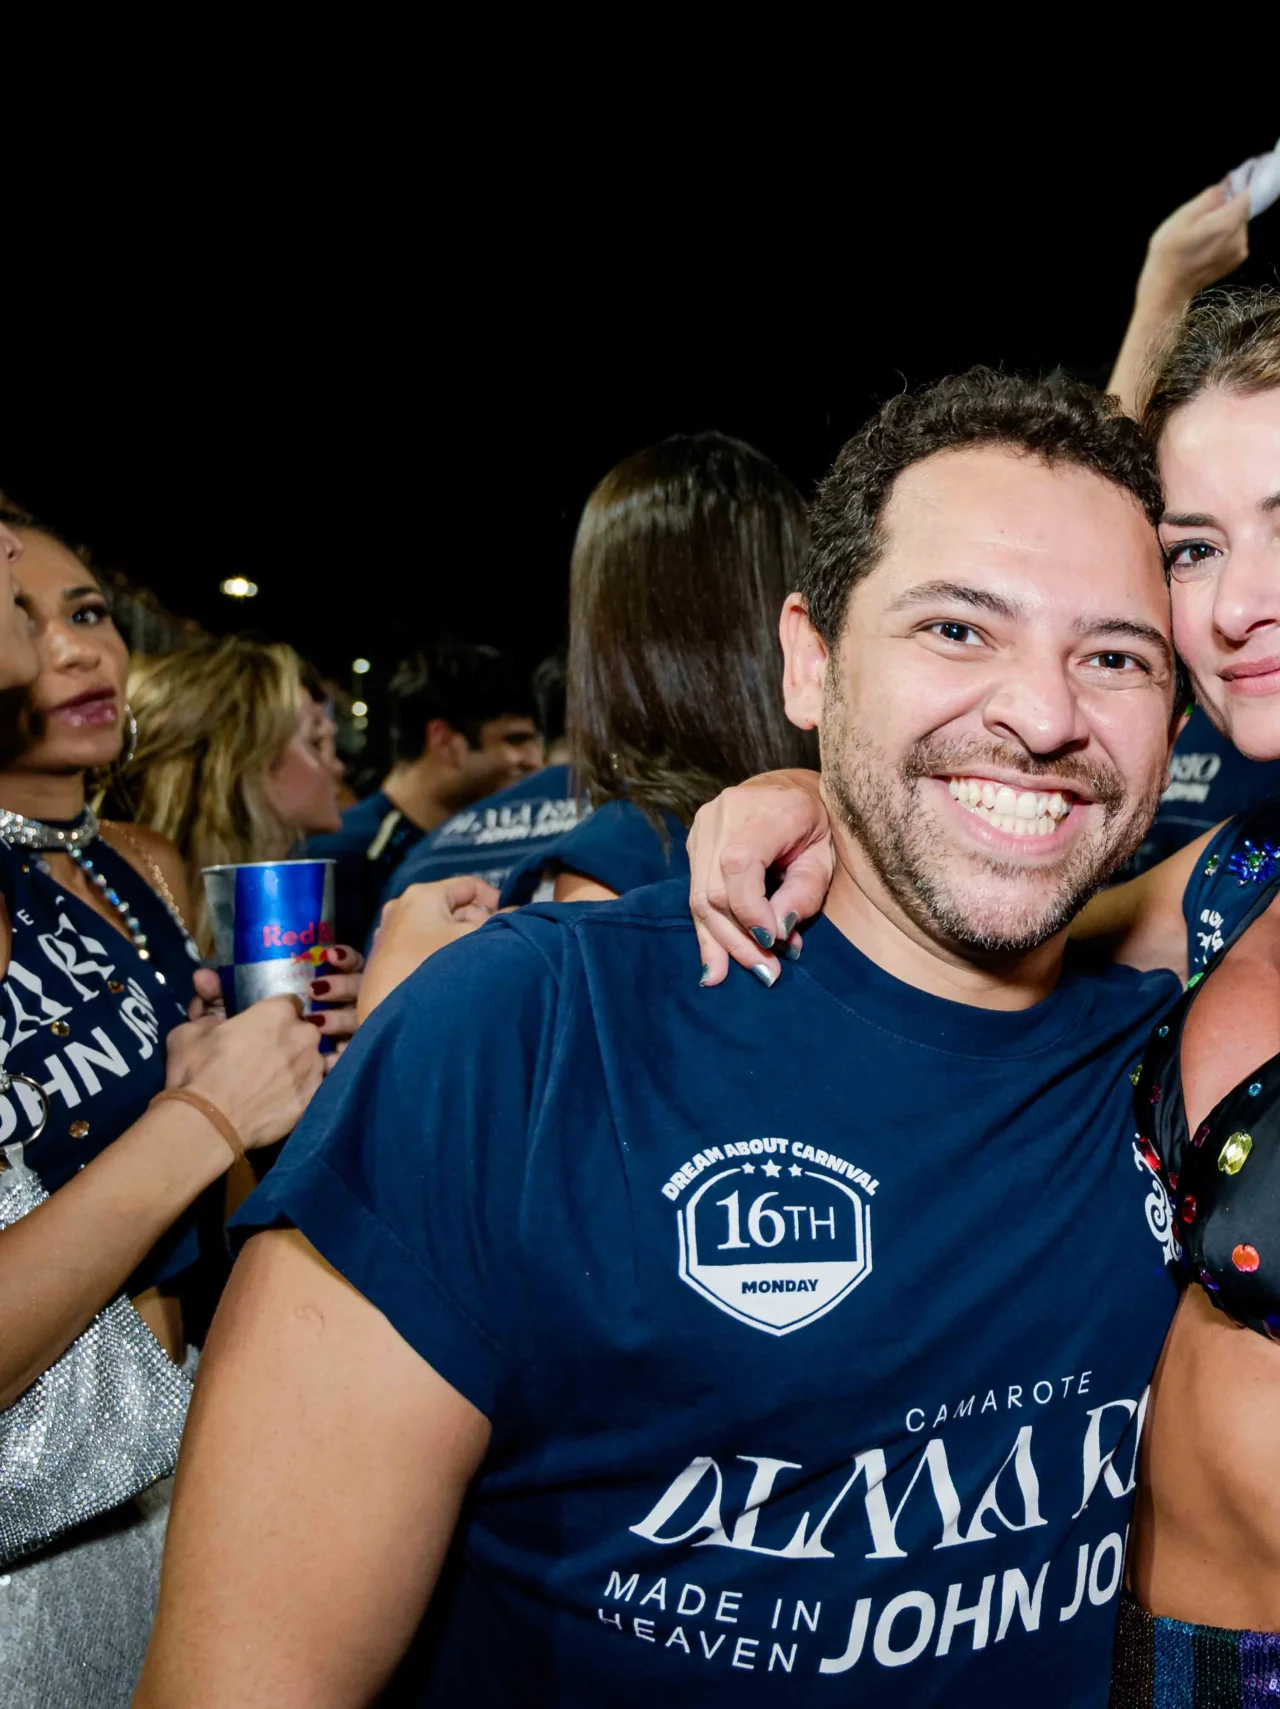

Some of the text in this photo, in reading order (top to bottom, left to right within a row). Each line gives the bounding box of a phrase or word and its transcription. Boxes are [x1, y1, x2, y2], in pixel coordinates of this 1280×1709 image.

[262, 921, 315, 948] Red
[661, 1137, 880, 1202] DREAM ABOUT CARNIVAL
[715, 1189, 836, 1250] 16TH
[741, 1278, 819, 1294] MONDAY
[905, 1370, 1092, 1432] CAMAROTE
[628, 1425, 1048, 1559] ALMA
[604, 1570, 821, 1632] MADE IN
[818, 1523, 1129, 1674] JOHN JO
[598, 1608, 798, 1673] HEAVEN
